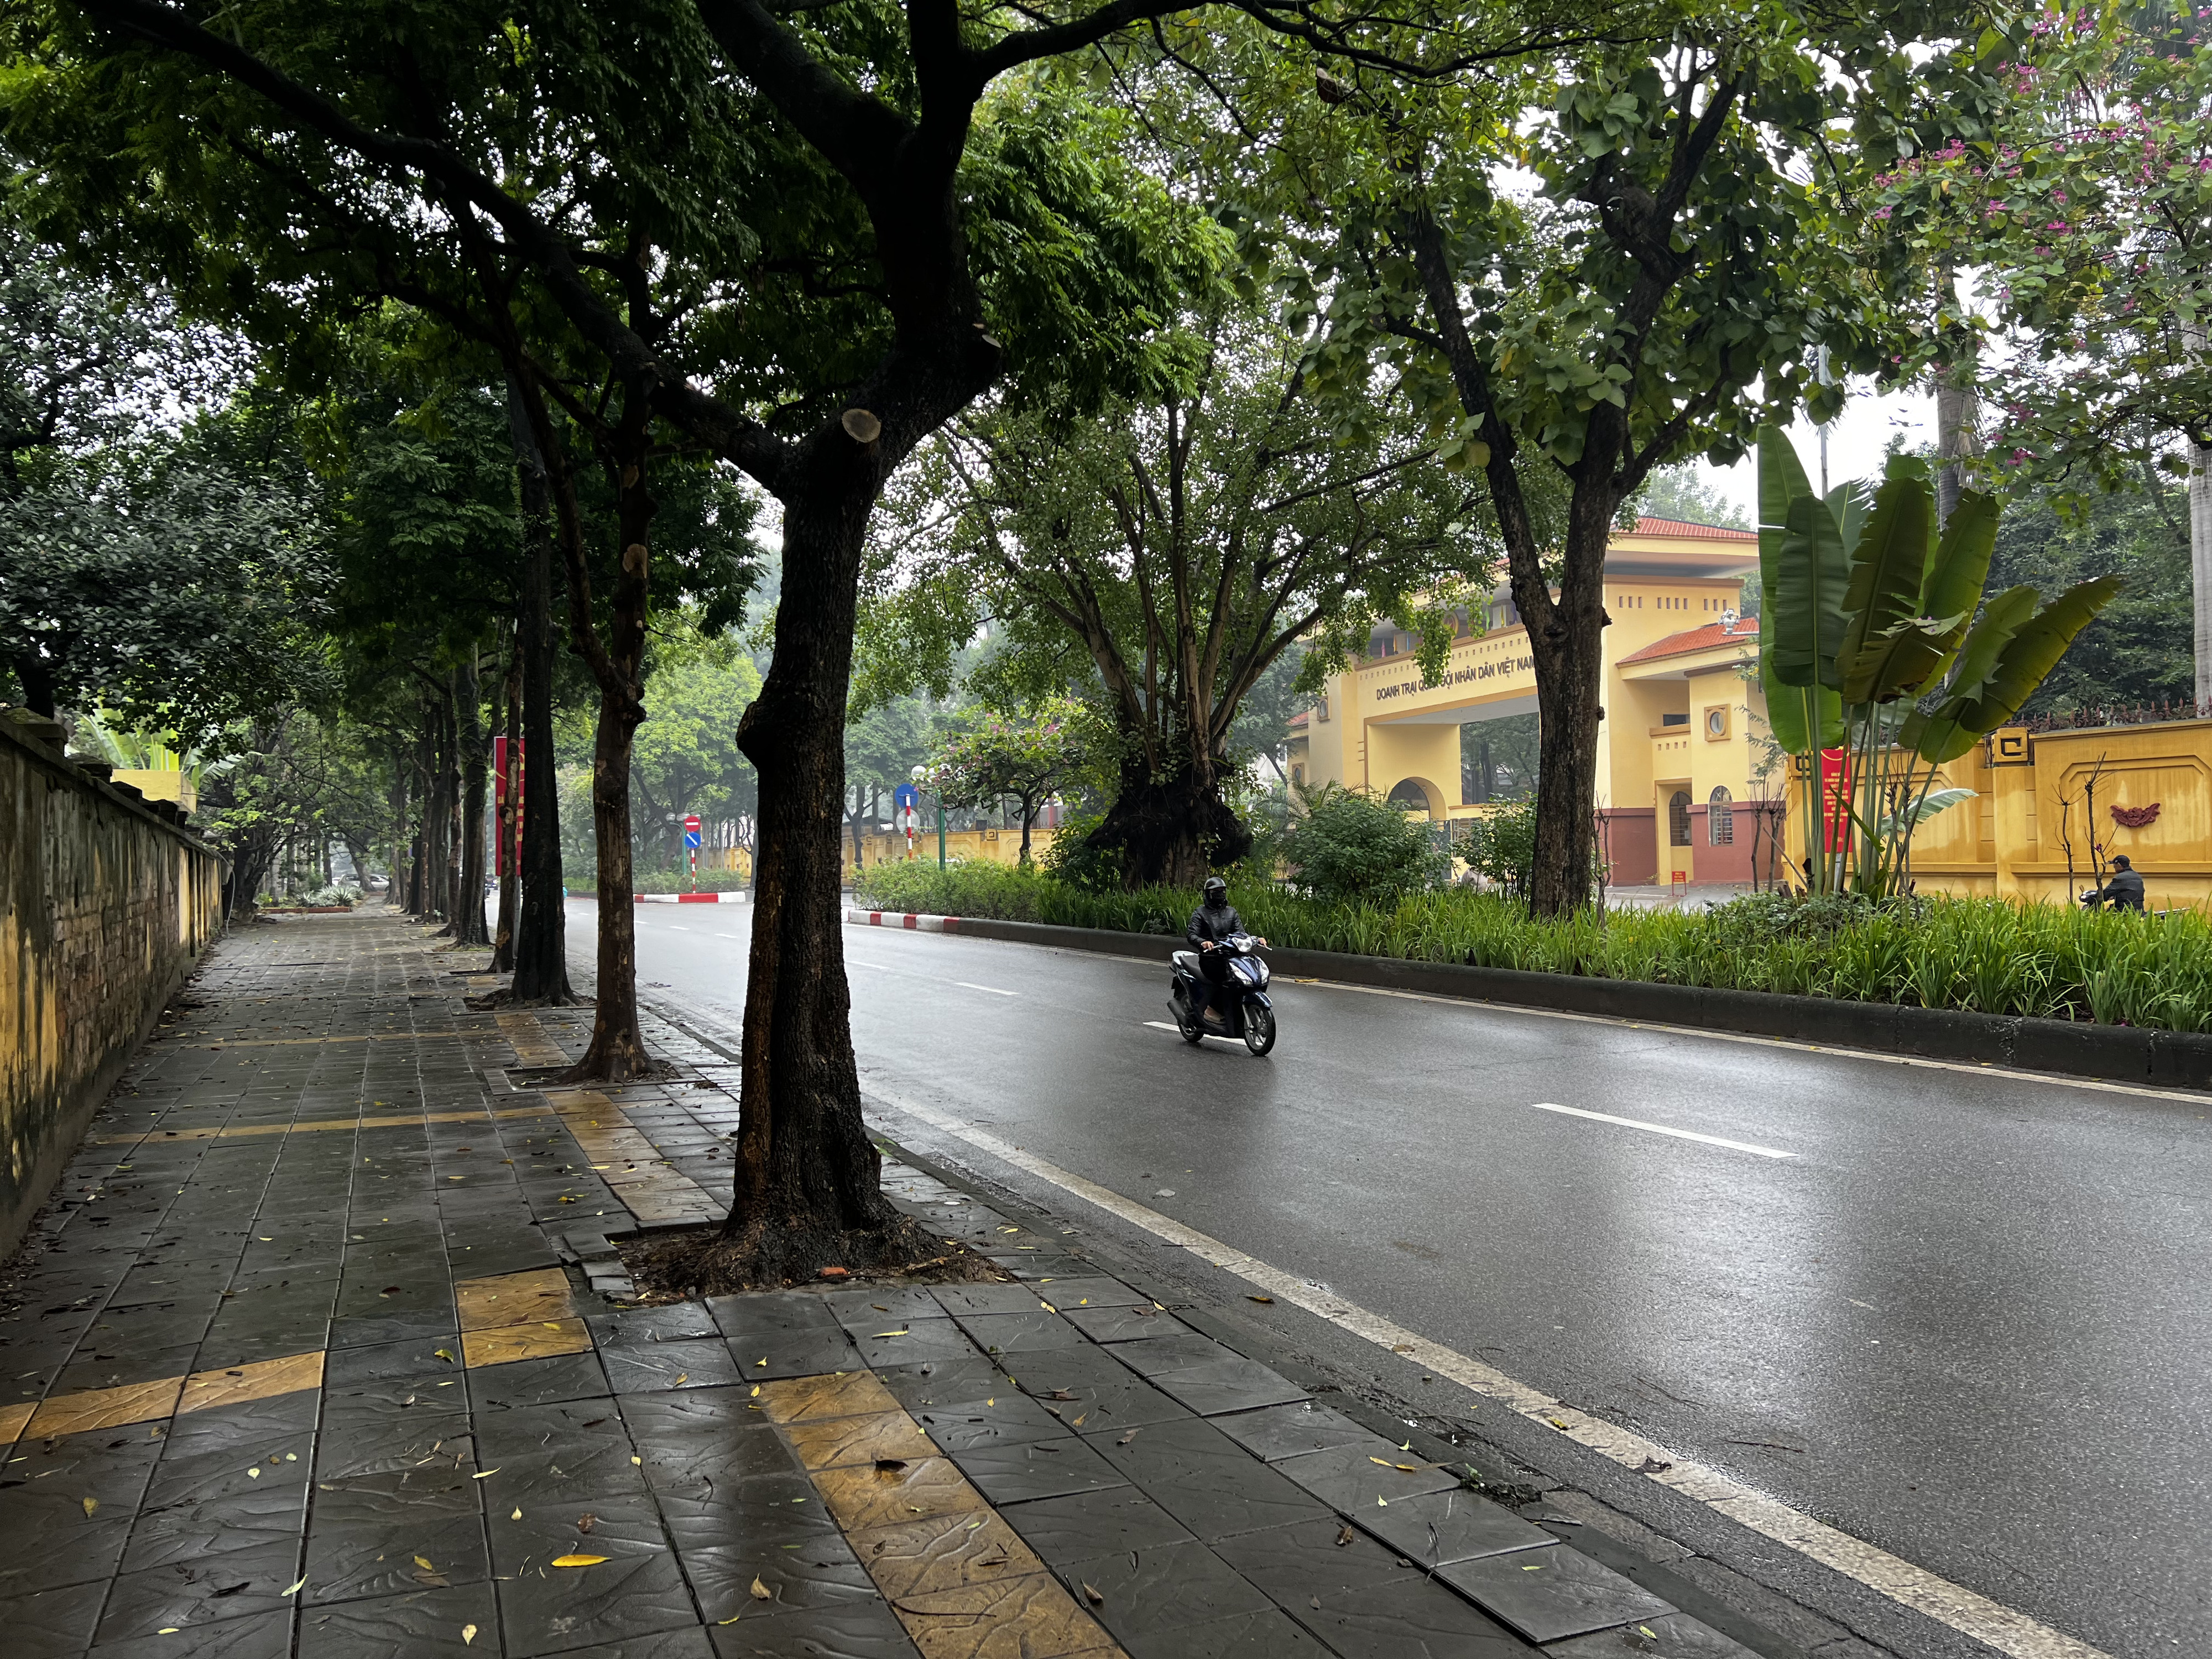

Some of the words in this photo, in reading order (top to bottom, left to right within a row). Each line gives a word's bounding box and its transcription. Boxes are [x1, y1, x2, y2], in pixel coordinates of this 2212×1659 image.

[1376, 685, 1400, 700] DOANH
[1401, 681, 1417, 696] TRẠI
[1455, 665, 1477, 684] NHÂN
[1478, 661, 1495, 679] DÂN
[1496, 656, 1516, 678] VIỆT
